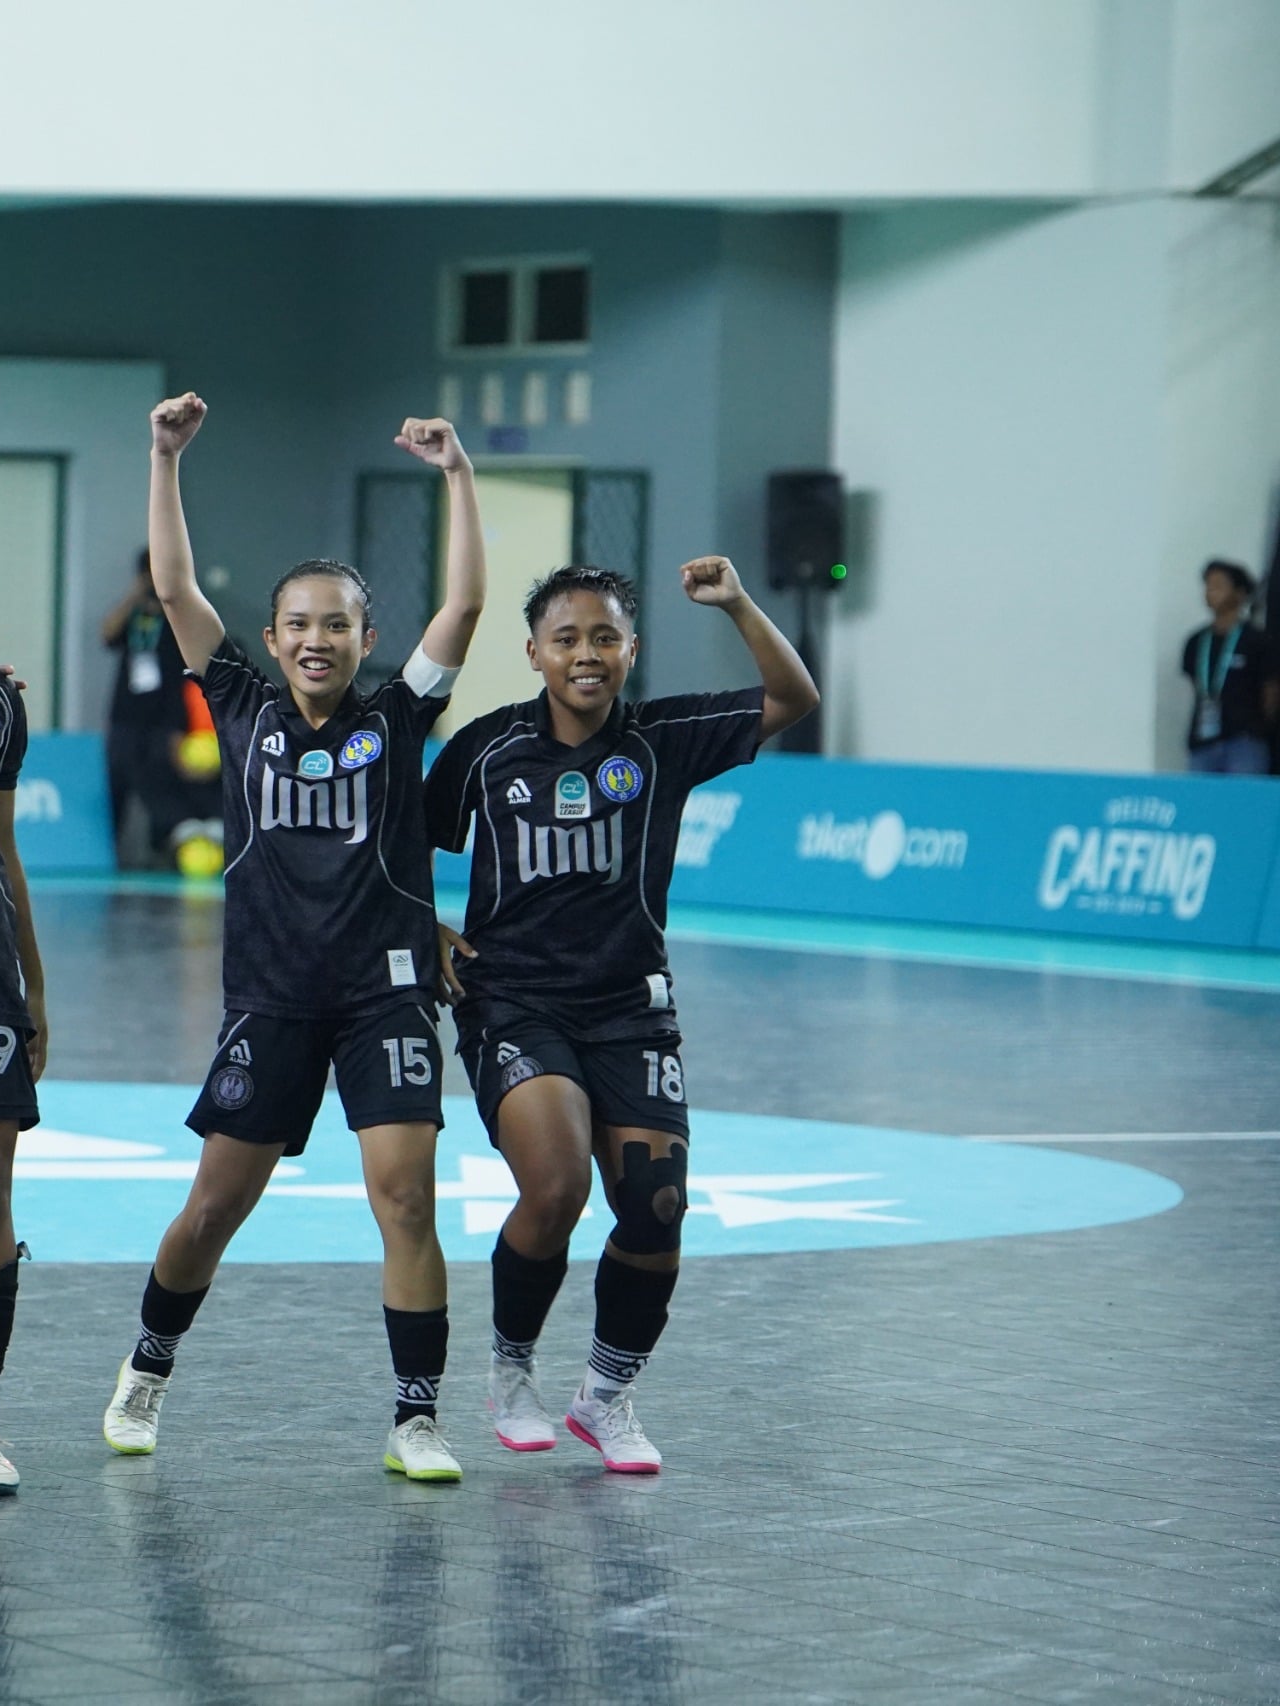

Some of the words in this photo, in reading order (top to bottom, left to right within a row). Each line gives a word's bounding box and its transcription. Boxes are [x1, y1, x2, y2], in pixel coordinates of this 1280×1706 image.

[509, 797, 531, 805] ALMER
[559, 802, 586, 810] CAMPUS
[559, 808, 585, 816] LEAGUE
[228, 1057, 251, 1066] ALMER
[382, 1037, 432, 1087] 15
[642, 1050, 685, 1103] 18
